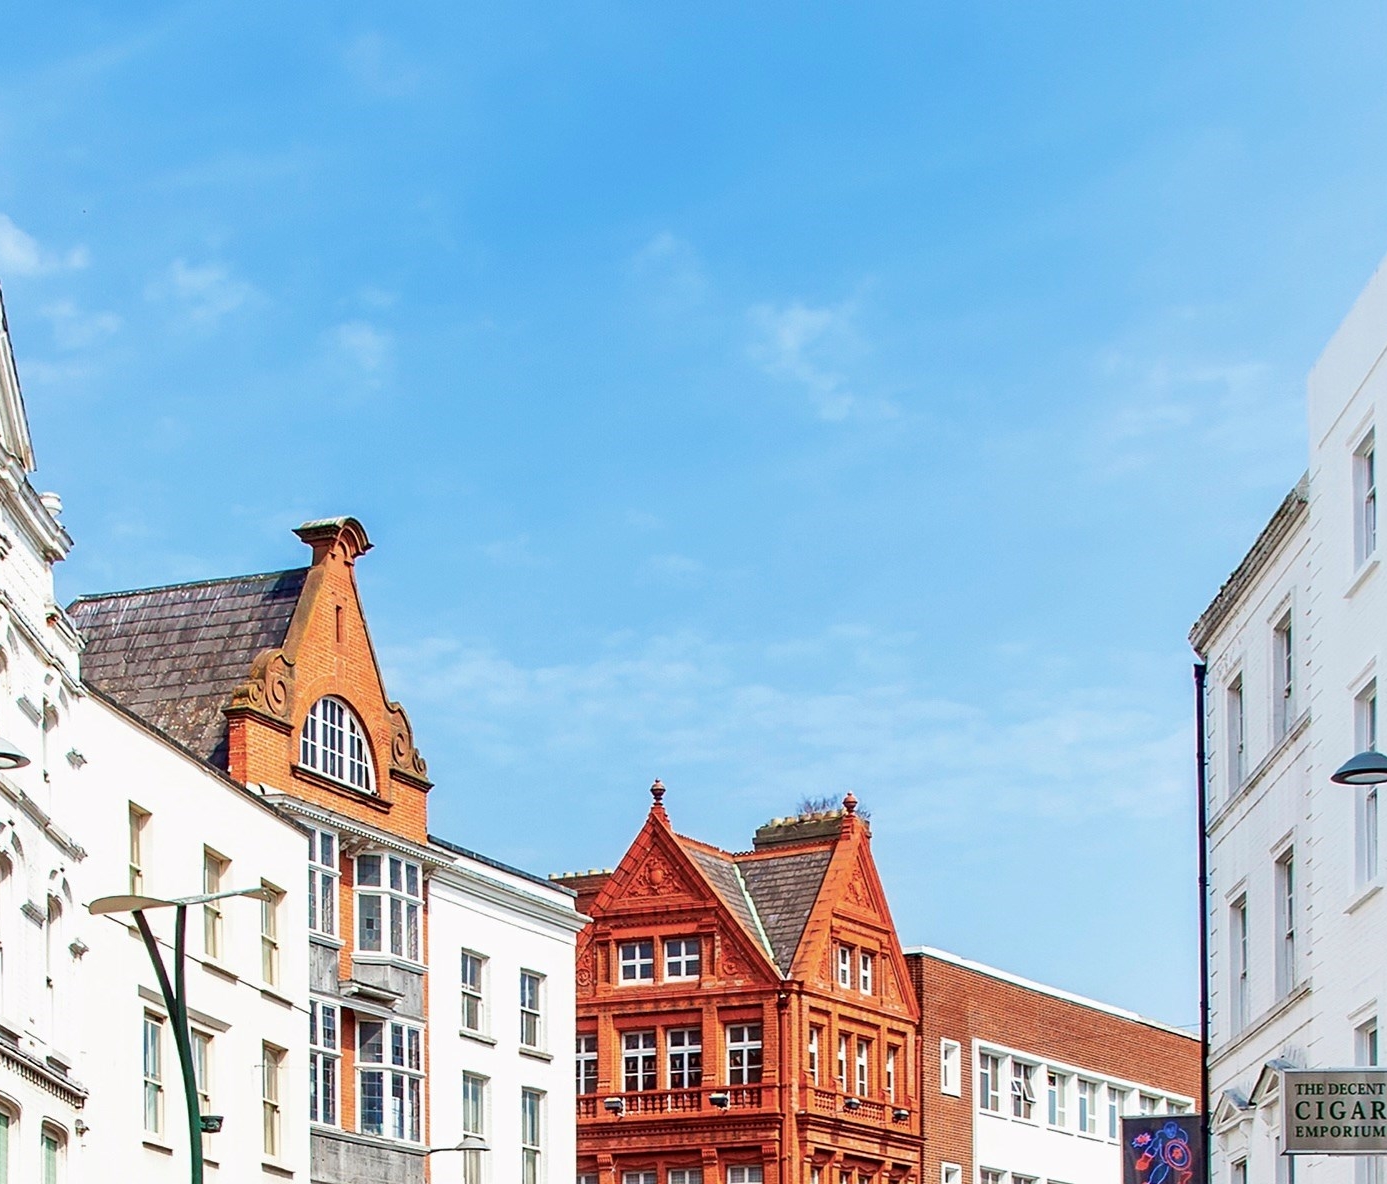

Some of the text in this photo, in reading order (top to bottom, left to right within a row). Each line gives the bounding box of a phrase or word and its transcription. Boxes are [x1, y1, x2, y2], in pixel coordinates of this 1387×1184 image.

[1294, 1082, 1386, 1096] THE DECENT
[1294, 1100, 1387, 1121] CIGAR
[1295, 1125, 1386, 1138] EMPORIUM
